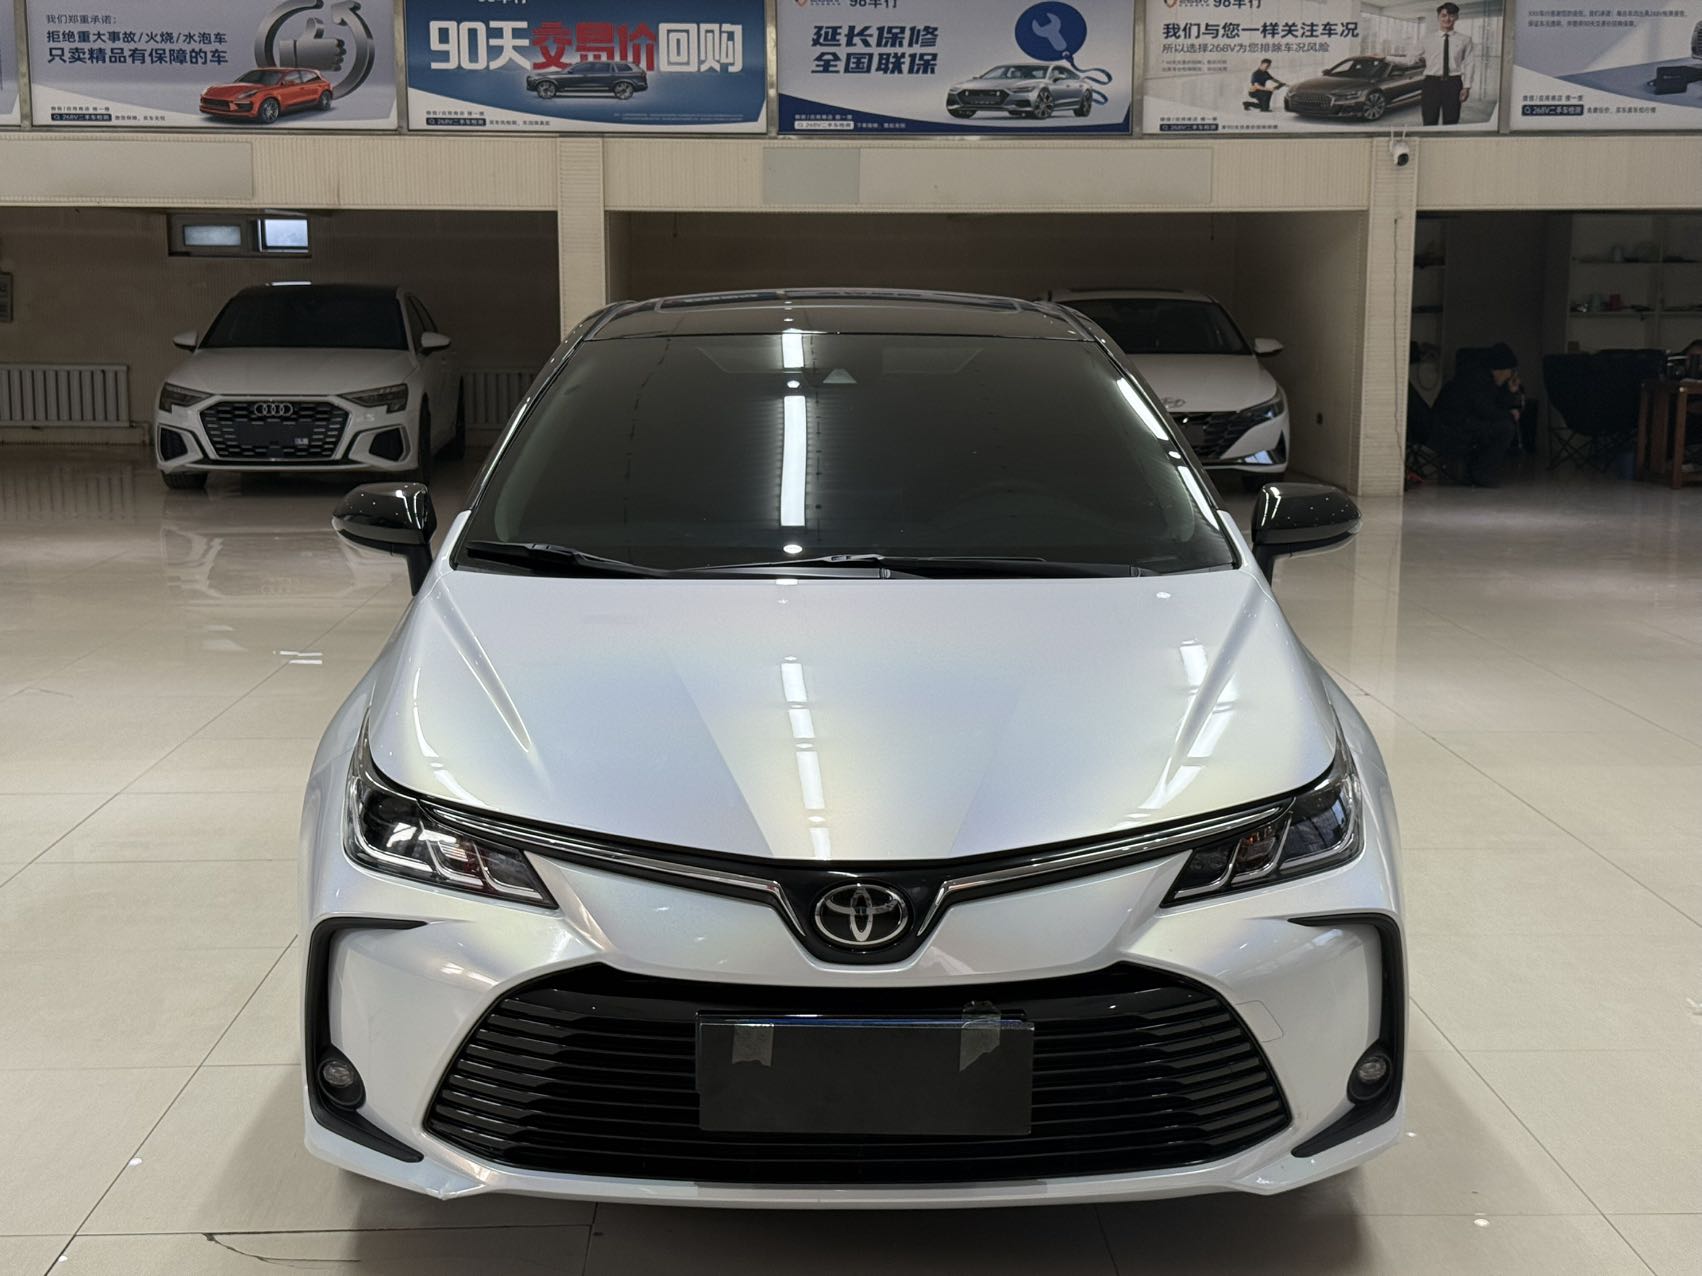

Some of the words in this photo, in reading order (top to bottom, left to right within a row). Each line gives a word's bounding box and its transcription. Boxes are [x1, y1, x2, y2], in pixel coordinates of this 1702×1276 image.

[46, 30, 228, 45] 拒绝重大事故/火烧/水泡车
[811, 25, 940, 49] 延长保修
[1162, 22, 1360, 40] 我们与您一样关注车况
[47, 47, 229, 66] 只卖精品有保障的车
[429, 20, 743, 72] 90天交易价回购
[811, 52, 939, 75] 全国联保
